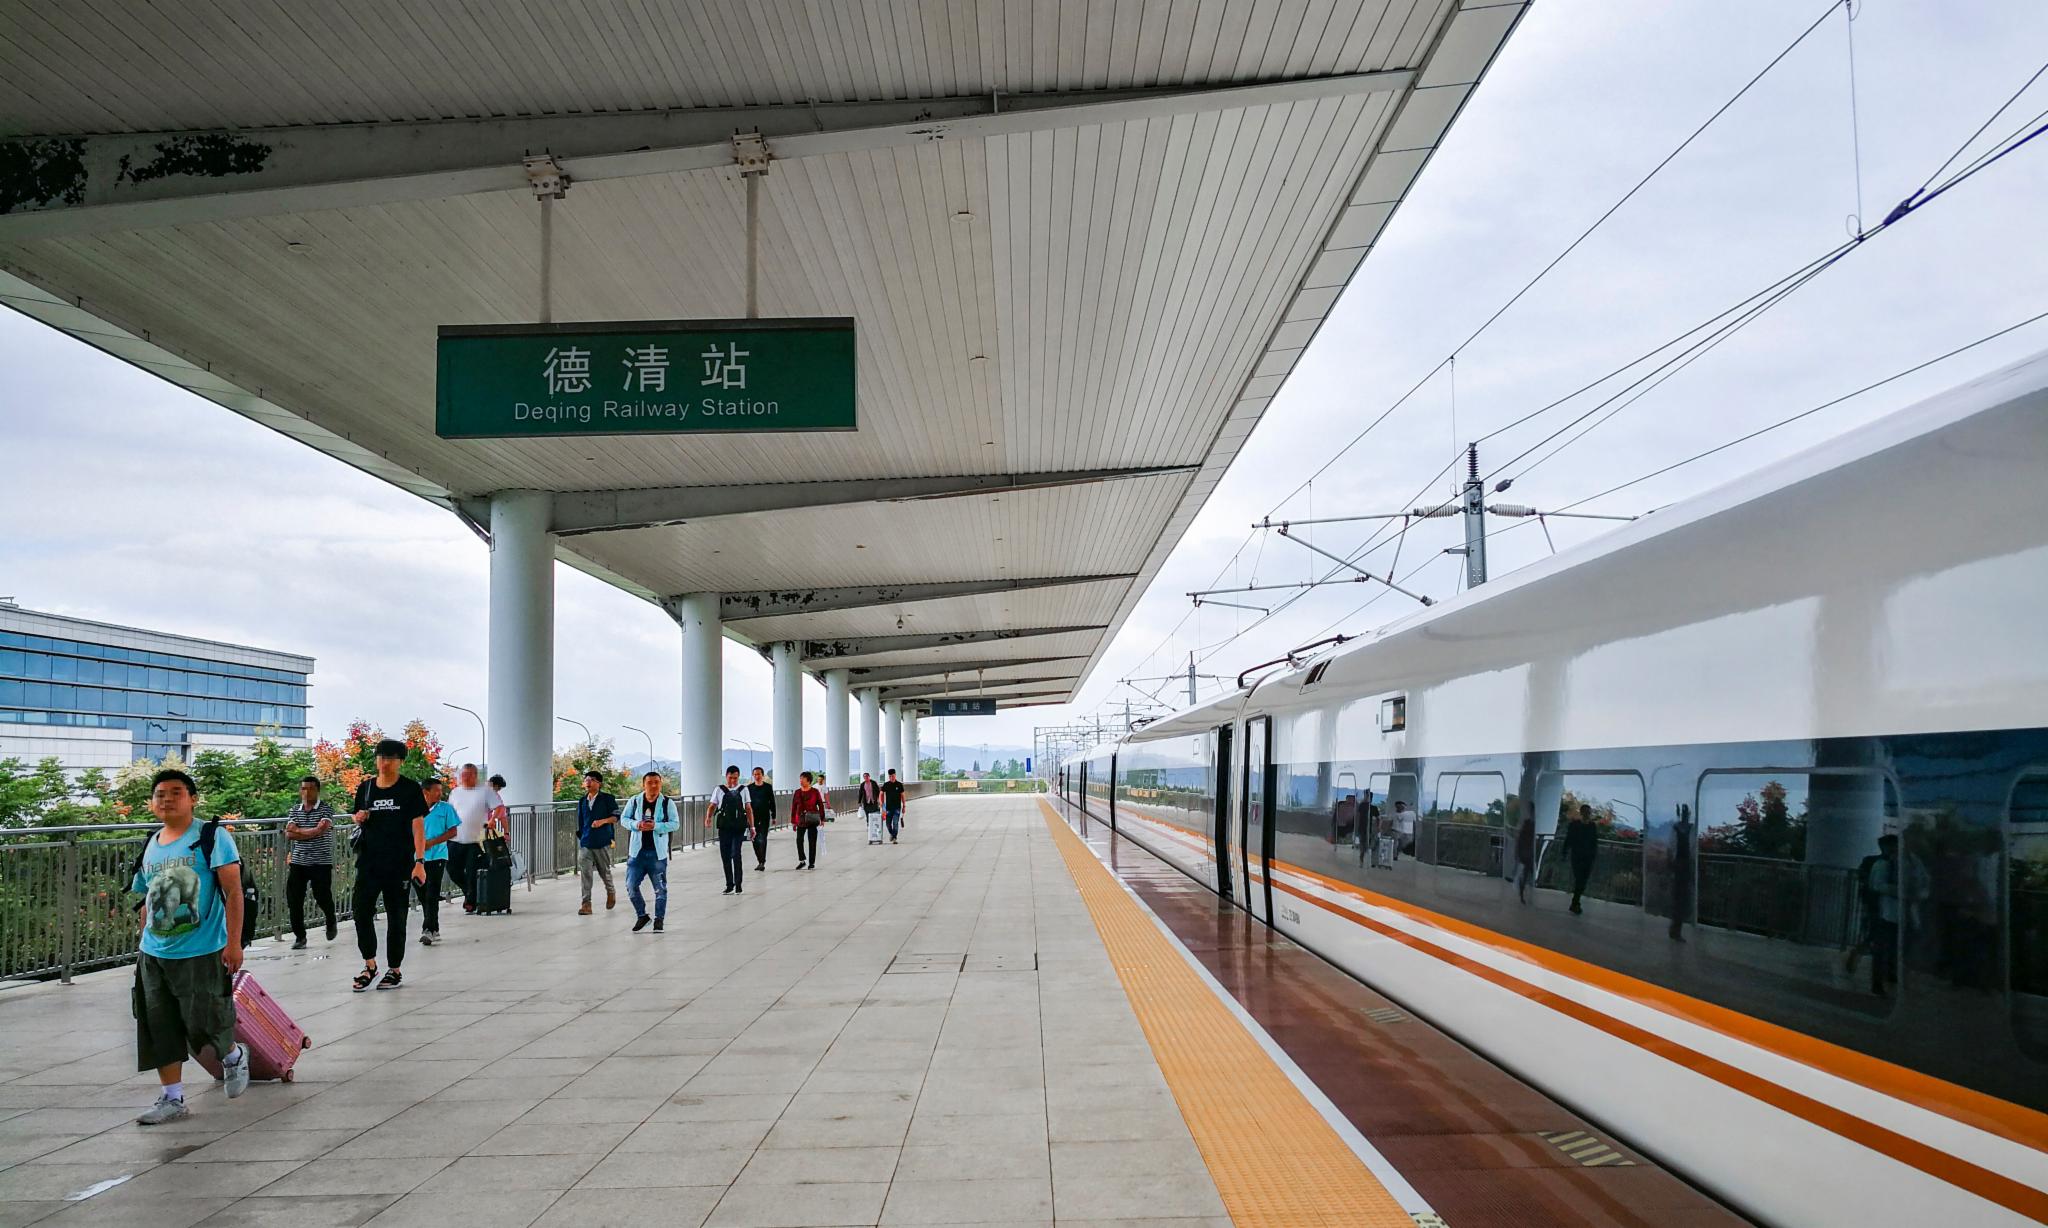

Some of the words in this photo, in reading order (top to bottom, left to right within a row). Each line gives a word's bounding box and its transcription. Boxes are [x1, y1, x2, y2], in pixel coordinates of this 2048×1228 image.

[543, 342, 750, 395] 德清站
[514, 402, 591, 423] Deqing
[603, 400, 690, 420] Railway
[702, 398, 779, 416] Station
